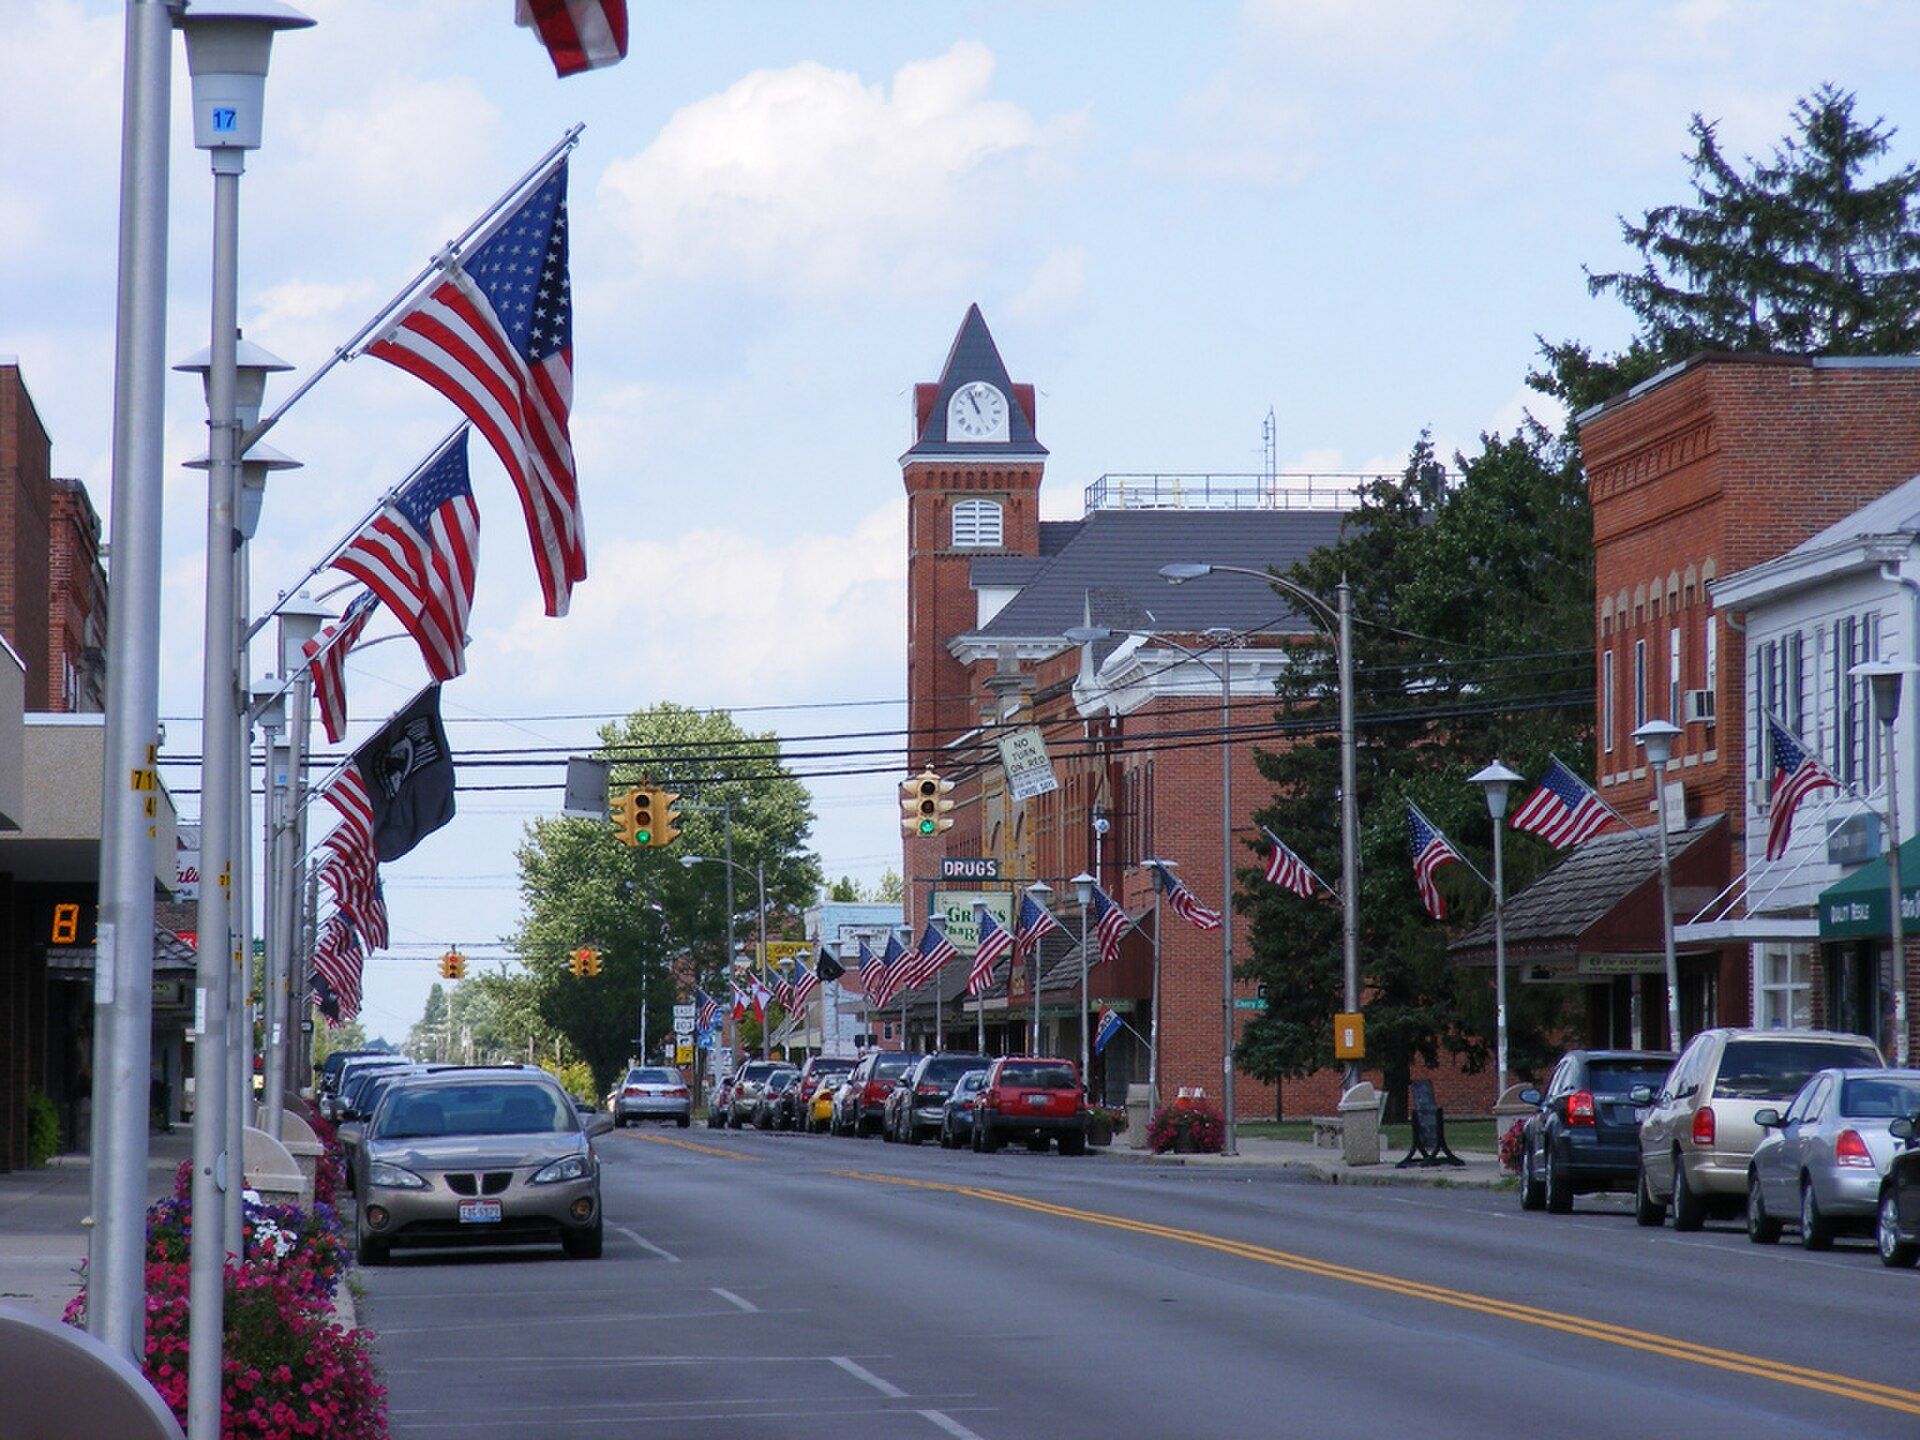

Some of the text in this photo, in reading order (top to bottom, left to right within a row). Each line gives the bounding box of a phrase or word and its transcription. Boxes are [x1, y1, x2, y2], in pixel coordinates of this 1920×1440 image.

[213, 110, 236, 128] 17
[1013, 738, 1029, 749] NO
[1011, 747, 1036, 761] TURN
[1027, 755, 1046, 766] RED
[944, 860, 997, 876] DRUGS
